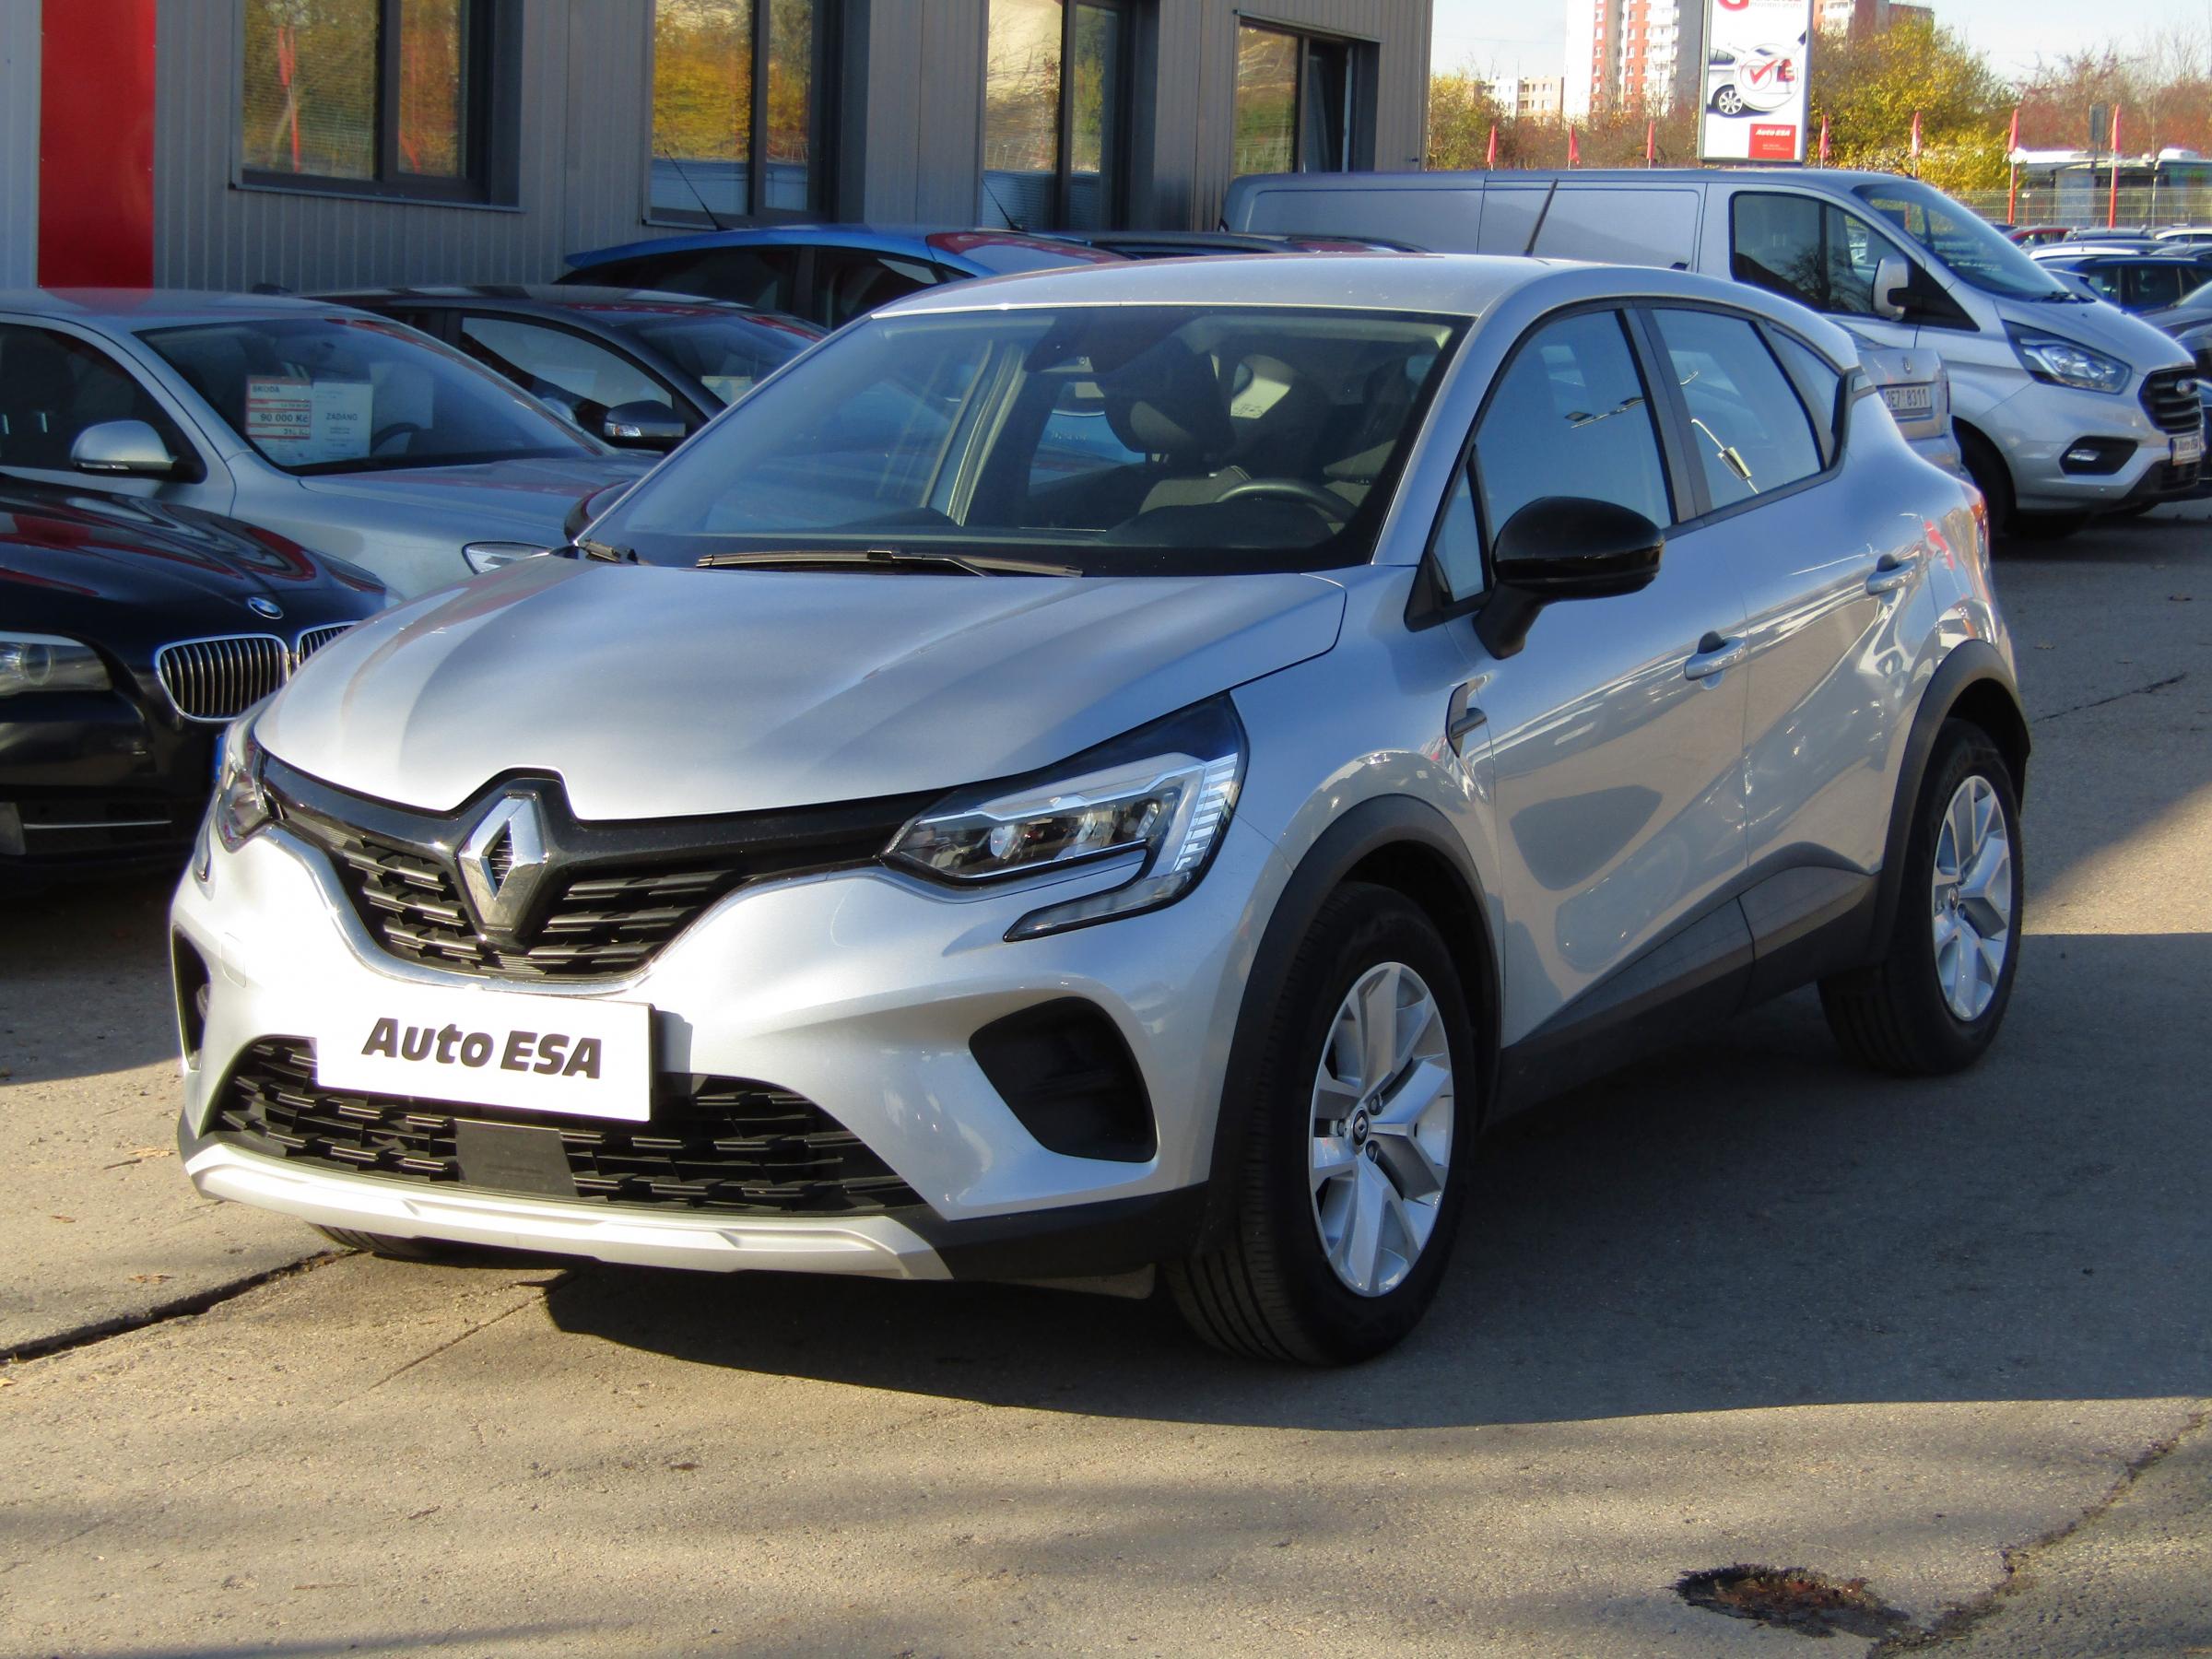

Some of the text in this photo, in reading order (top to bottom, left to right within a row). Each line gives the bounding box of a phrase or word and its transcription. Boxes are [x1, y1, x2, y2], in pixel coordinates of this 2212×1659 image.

[260, 413, 273, 422] 90
[275, 413, 294, 422] 000
[361, 1018, 602, 1079] Auto ESA
